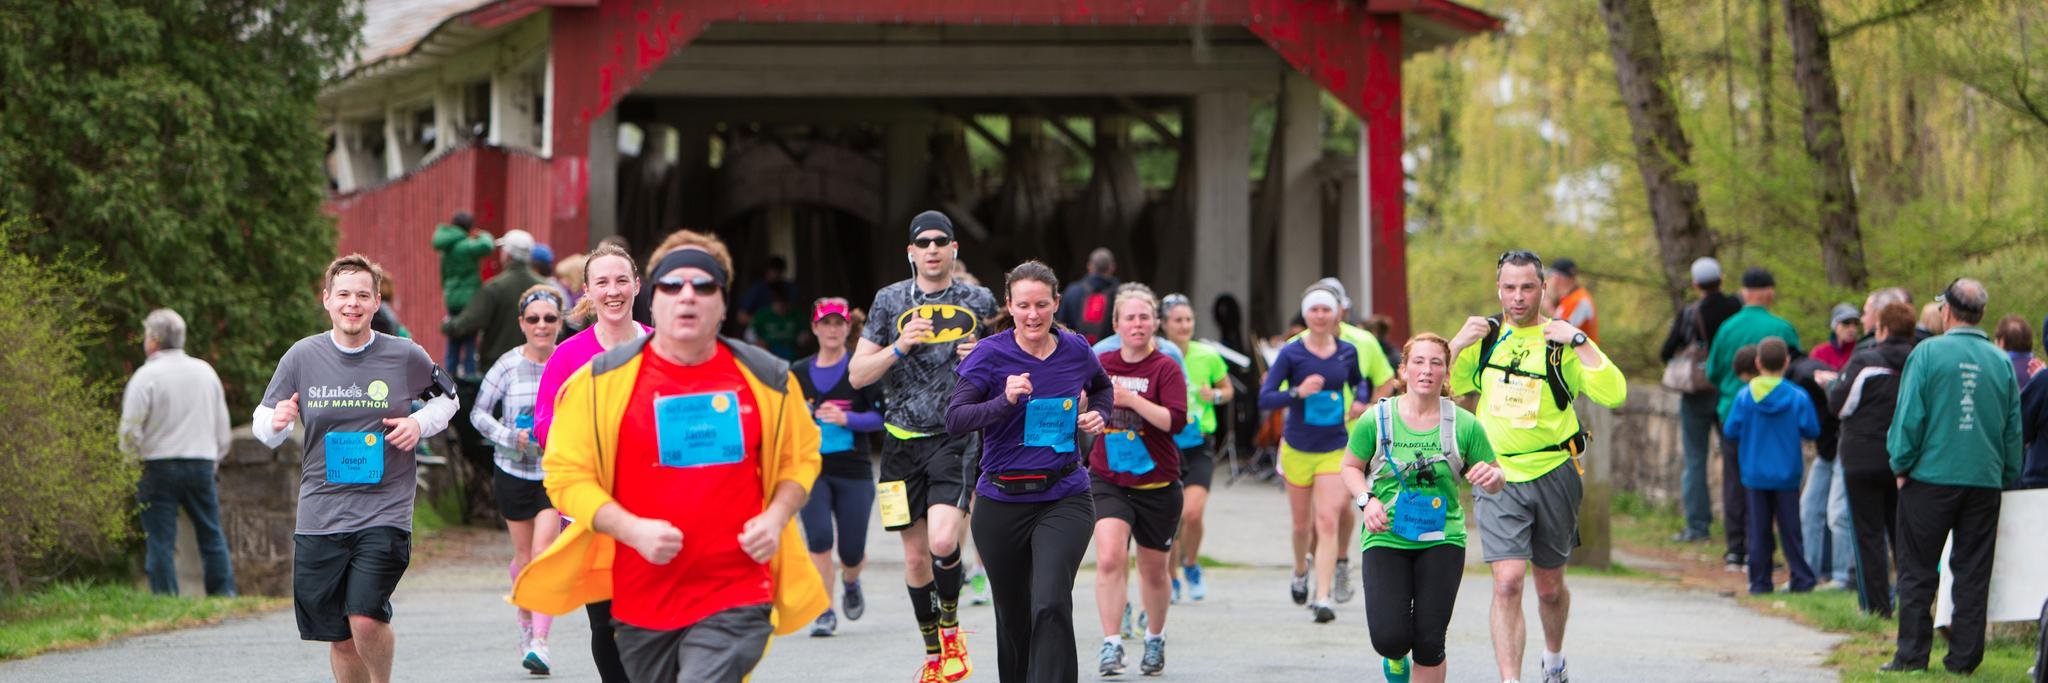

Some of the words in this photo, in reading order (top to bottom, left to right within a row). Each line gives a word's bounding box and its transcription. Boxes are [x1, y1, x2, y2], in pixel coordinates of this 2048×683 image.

[1505, 395, 1523, 404] Lewis
[307, 400, 329, 408] HALF
[332, 400, 389, 409] MARATHON
[684, 430, 717, 441] James
[341, 456, 367, 465] Joseph
[328, 469, 340, 478] 2711
[368, 470, 383, 479] 2711
